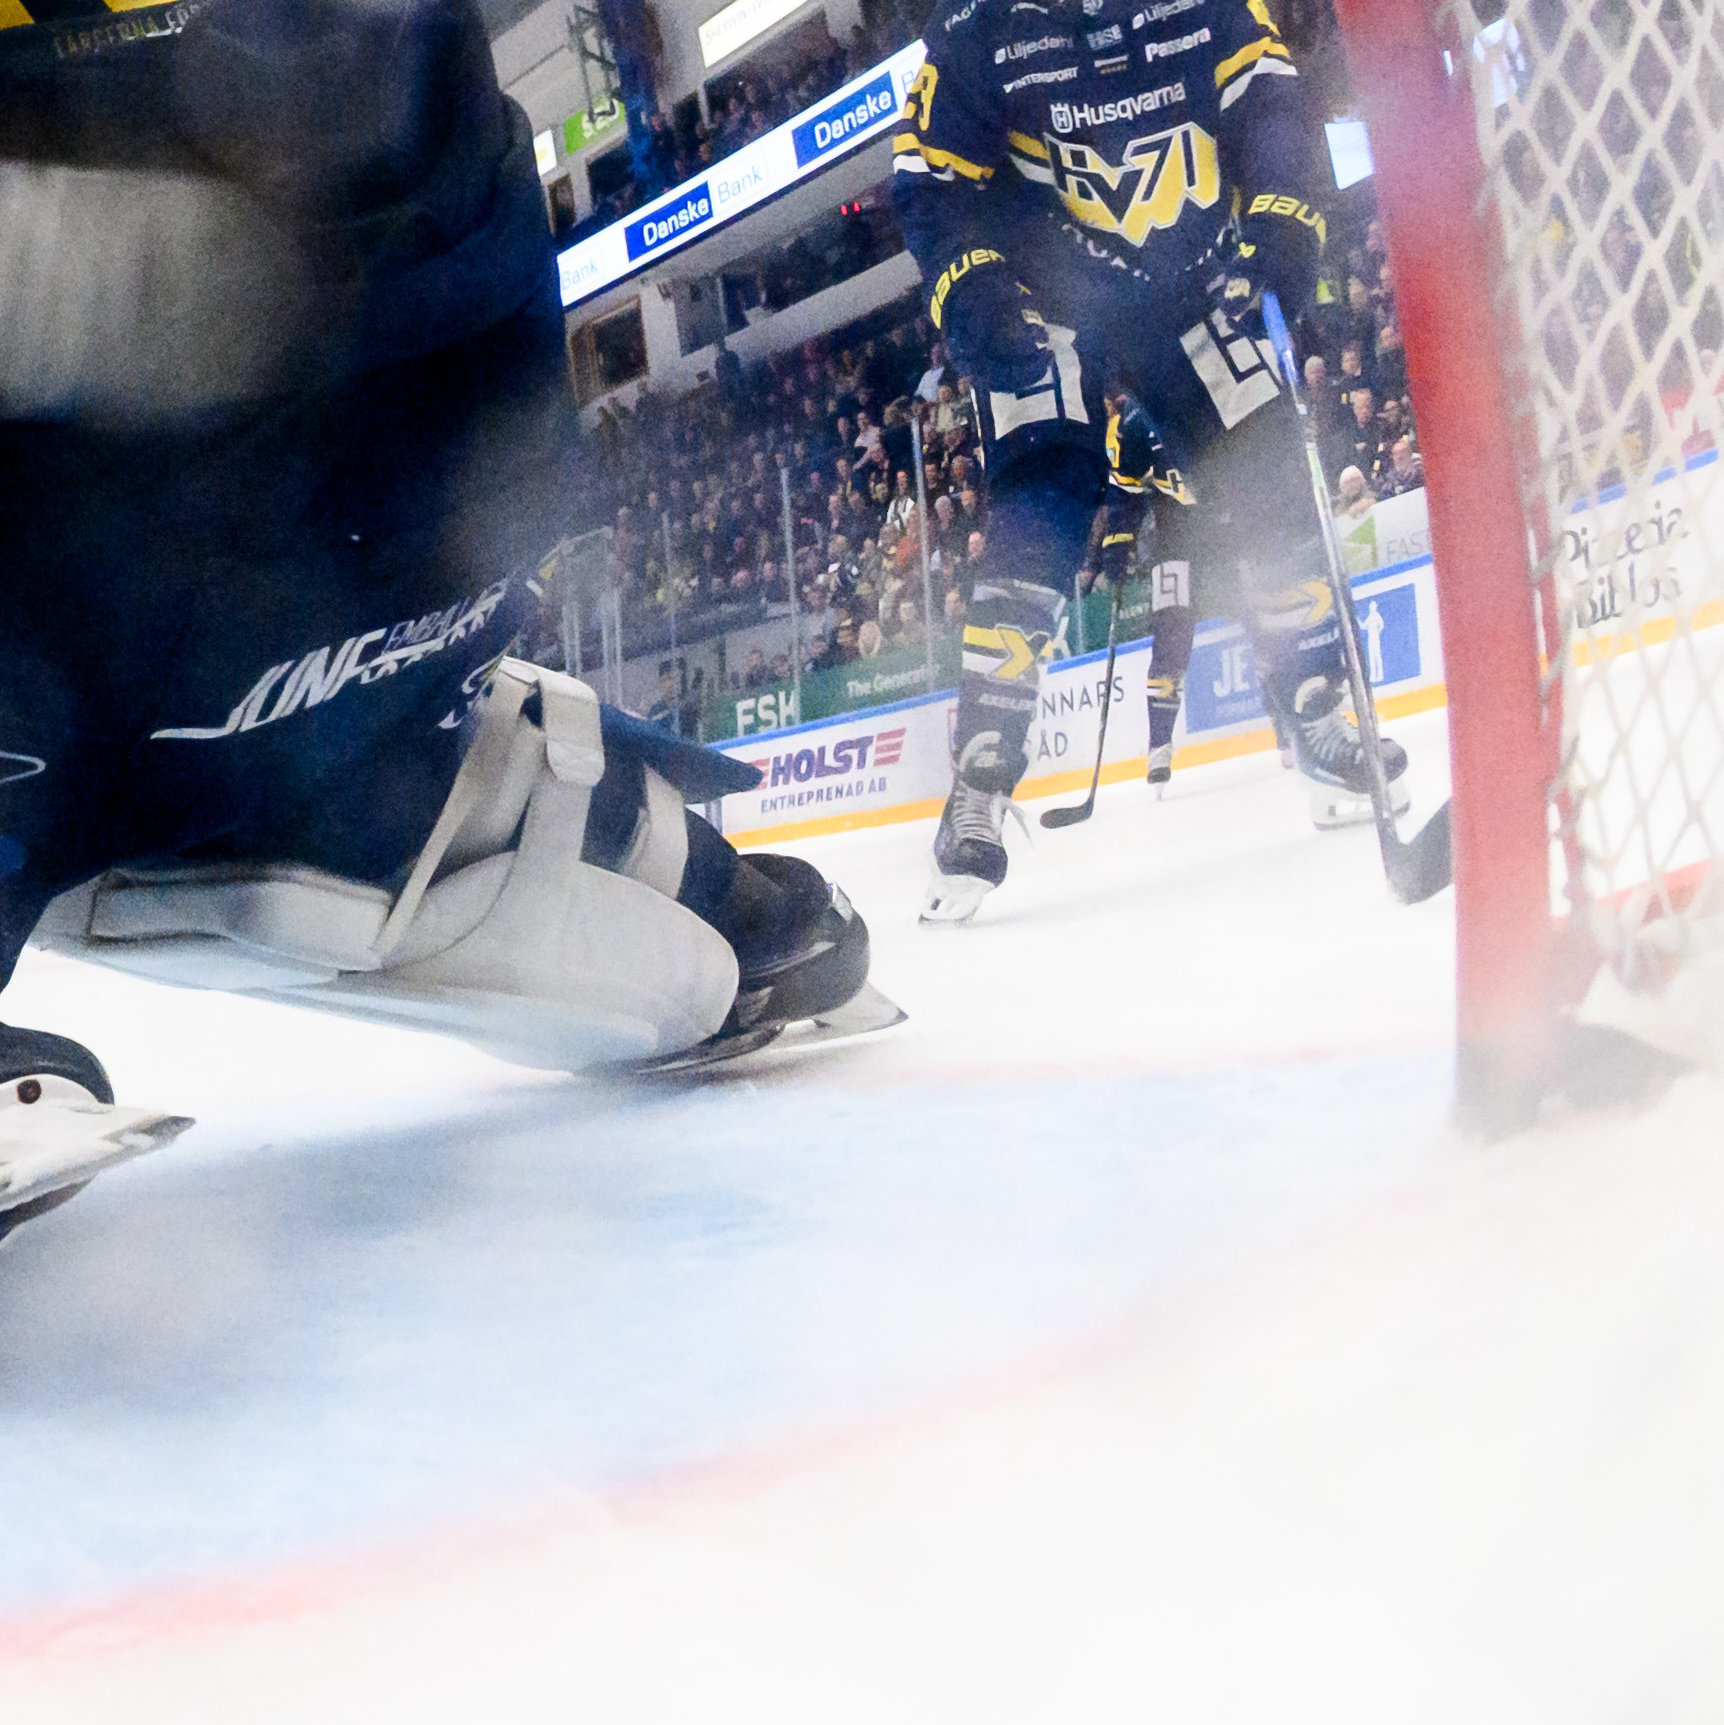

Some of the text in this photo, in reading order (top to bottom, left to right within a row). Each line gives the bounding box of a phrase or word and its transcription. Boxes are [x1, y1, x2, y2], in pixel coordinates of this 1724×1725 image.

[813, 89, 893, 150] Danske
[1072, 81, 1187, 129] Husqvarna
[643, 165, 765, 246] Danske Bank
[770, 734, 875, 789] HOLST
[760, 776, 888, 814] ENTREPRENAD AB
